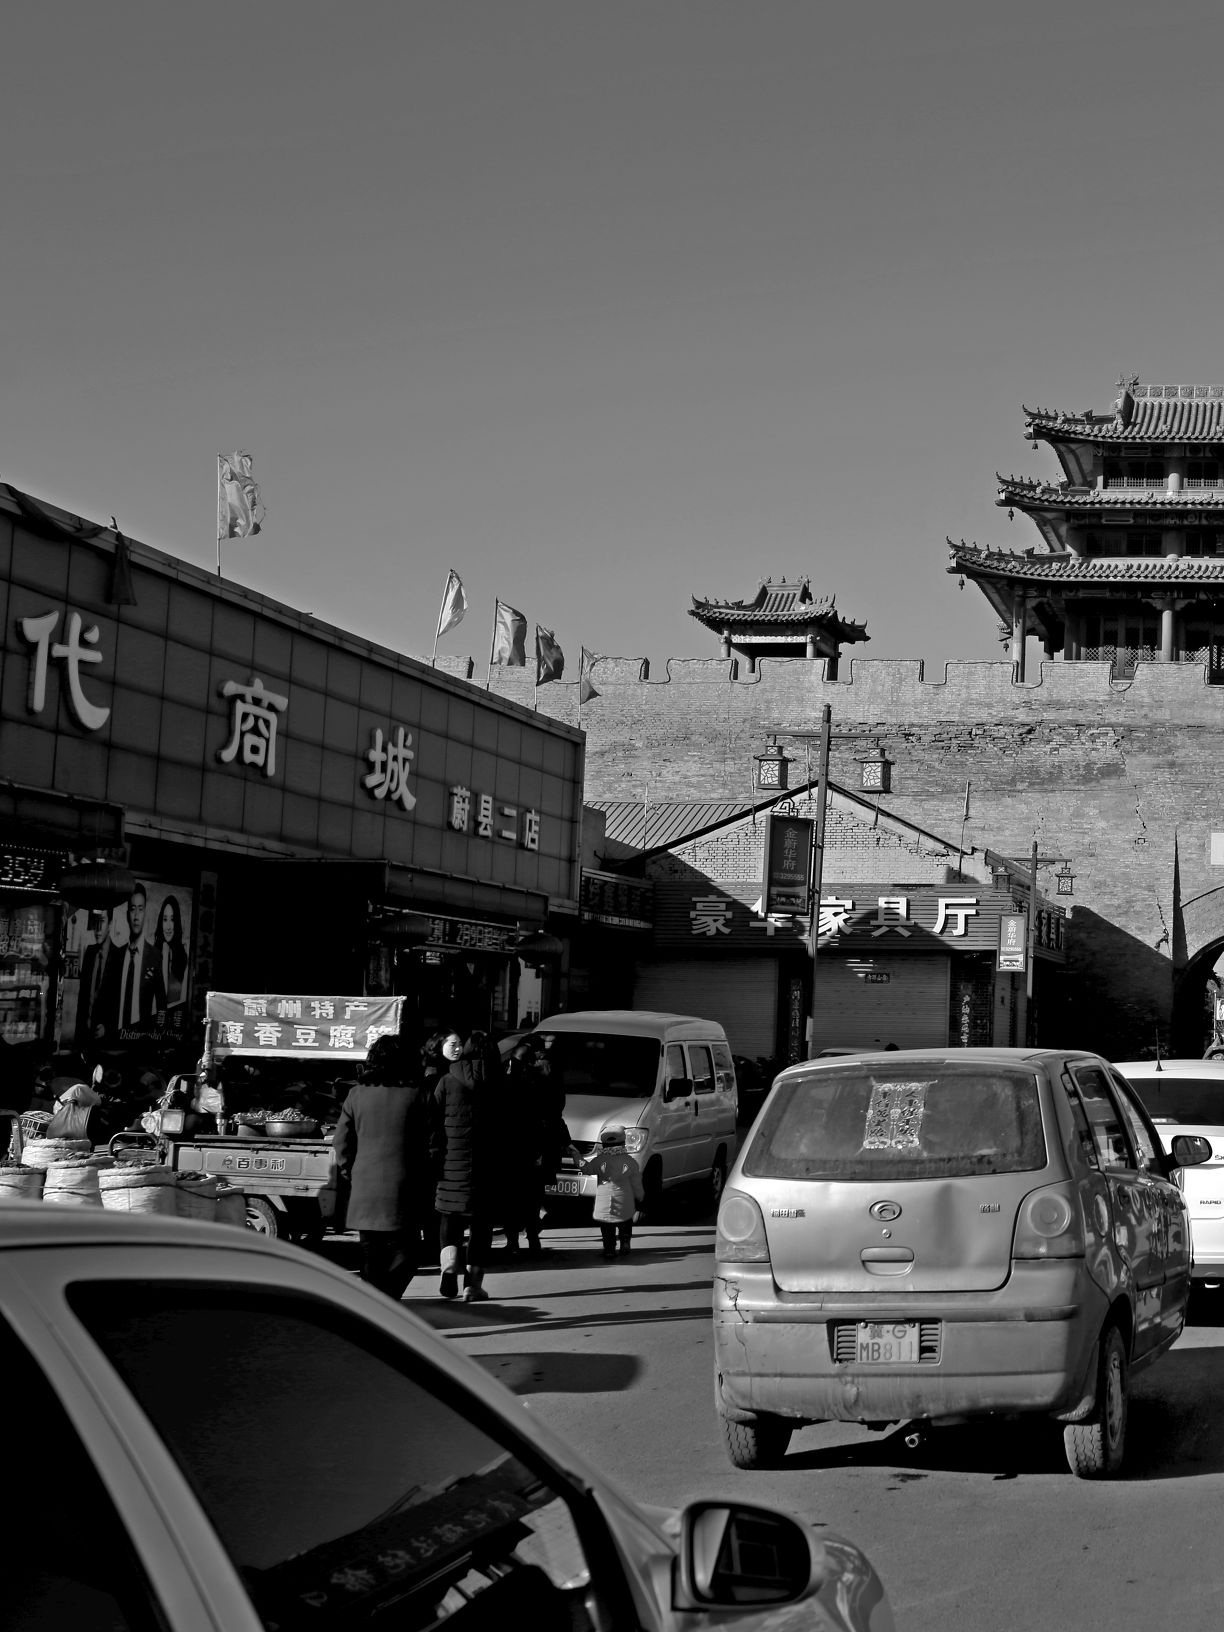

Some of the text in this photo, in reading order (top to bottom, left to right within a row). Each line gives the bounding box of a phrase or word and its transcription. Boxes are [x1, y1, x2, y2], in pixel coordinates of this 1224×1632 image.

[20, 609, 417, 812] 代商城
[449, 784, 541, 851] 蔚县二店
[242, 998, 368, 1020] 蔚州特产
